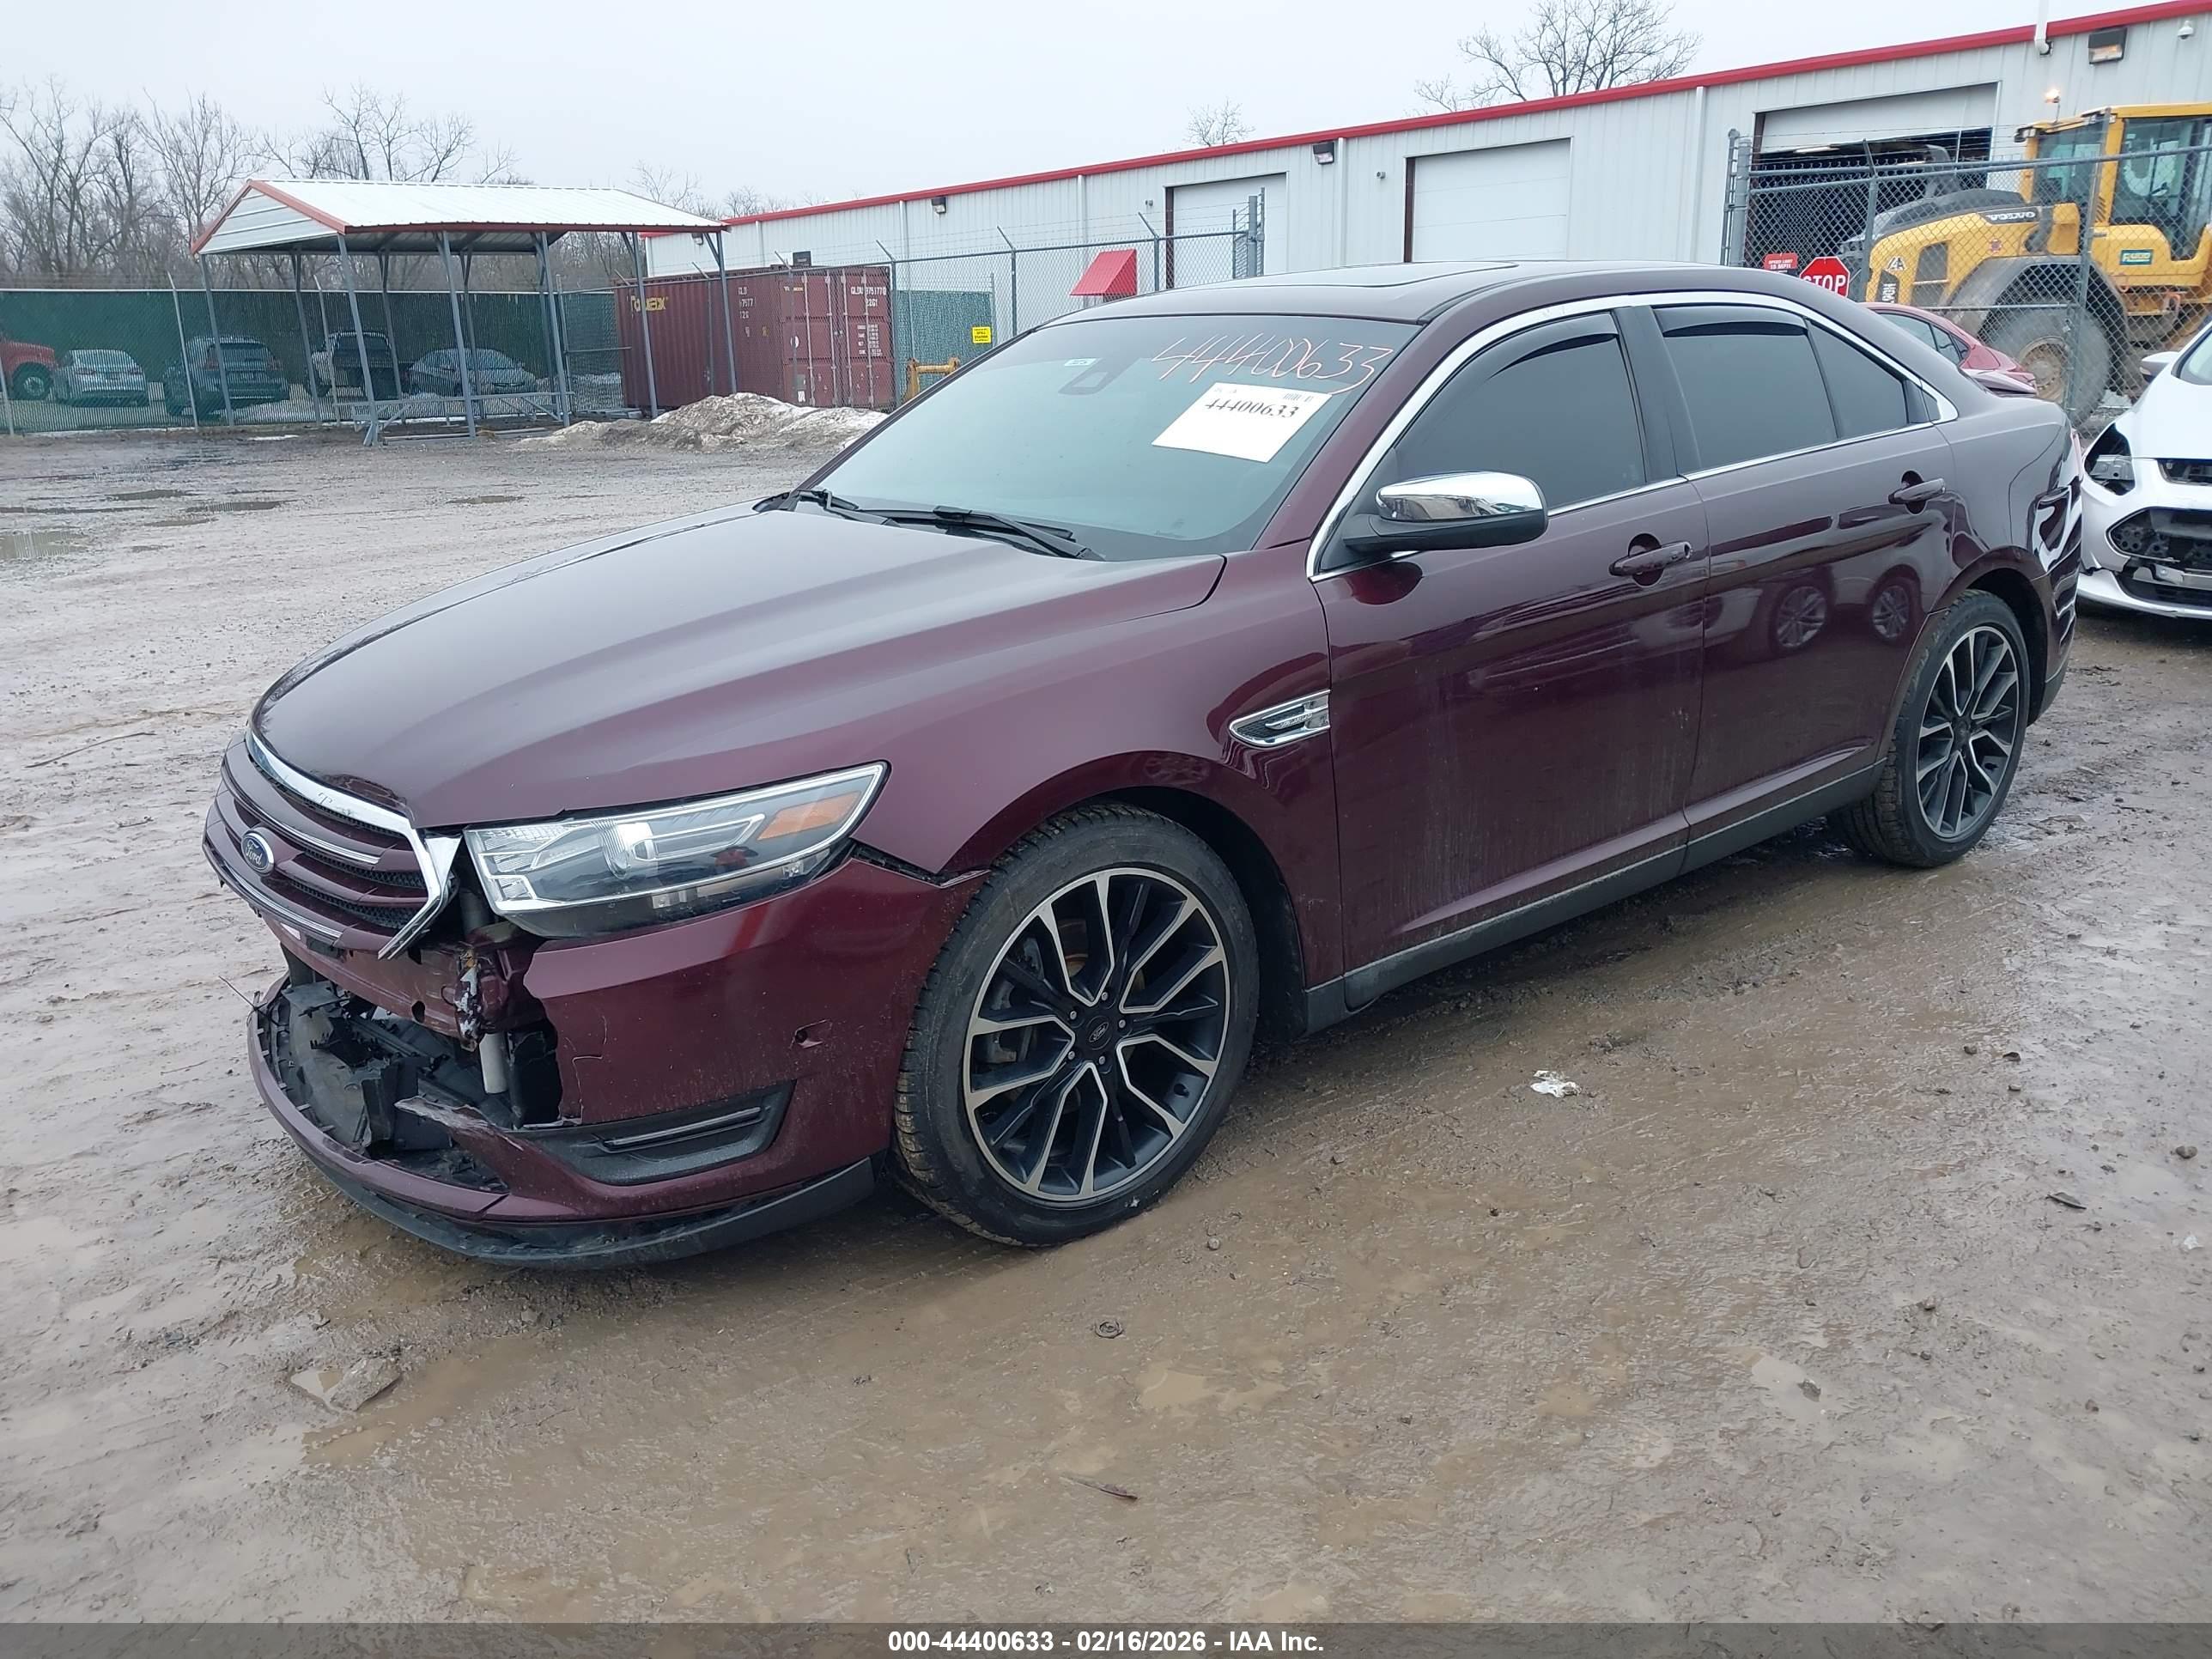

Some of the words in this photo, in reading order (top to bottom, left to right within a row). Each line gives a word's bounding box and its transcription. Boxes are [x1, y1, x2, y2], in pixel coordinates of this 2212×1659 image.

[1985, 211, 2035, 221] VOLVO
[1151, 332, 1394, 395] 44400633
[1204, 398, 1300, 418] 44400633
[245, 840, 264, 866] Ford
